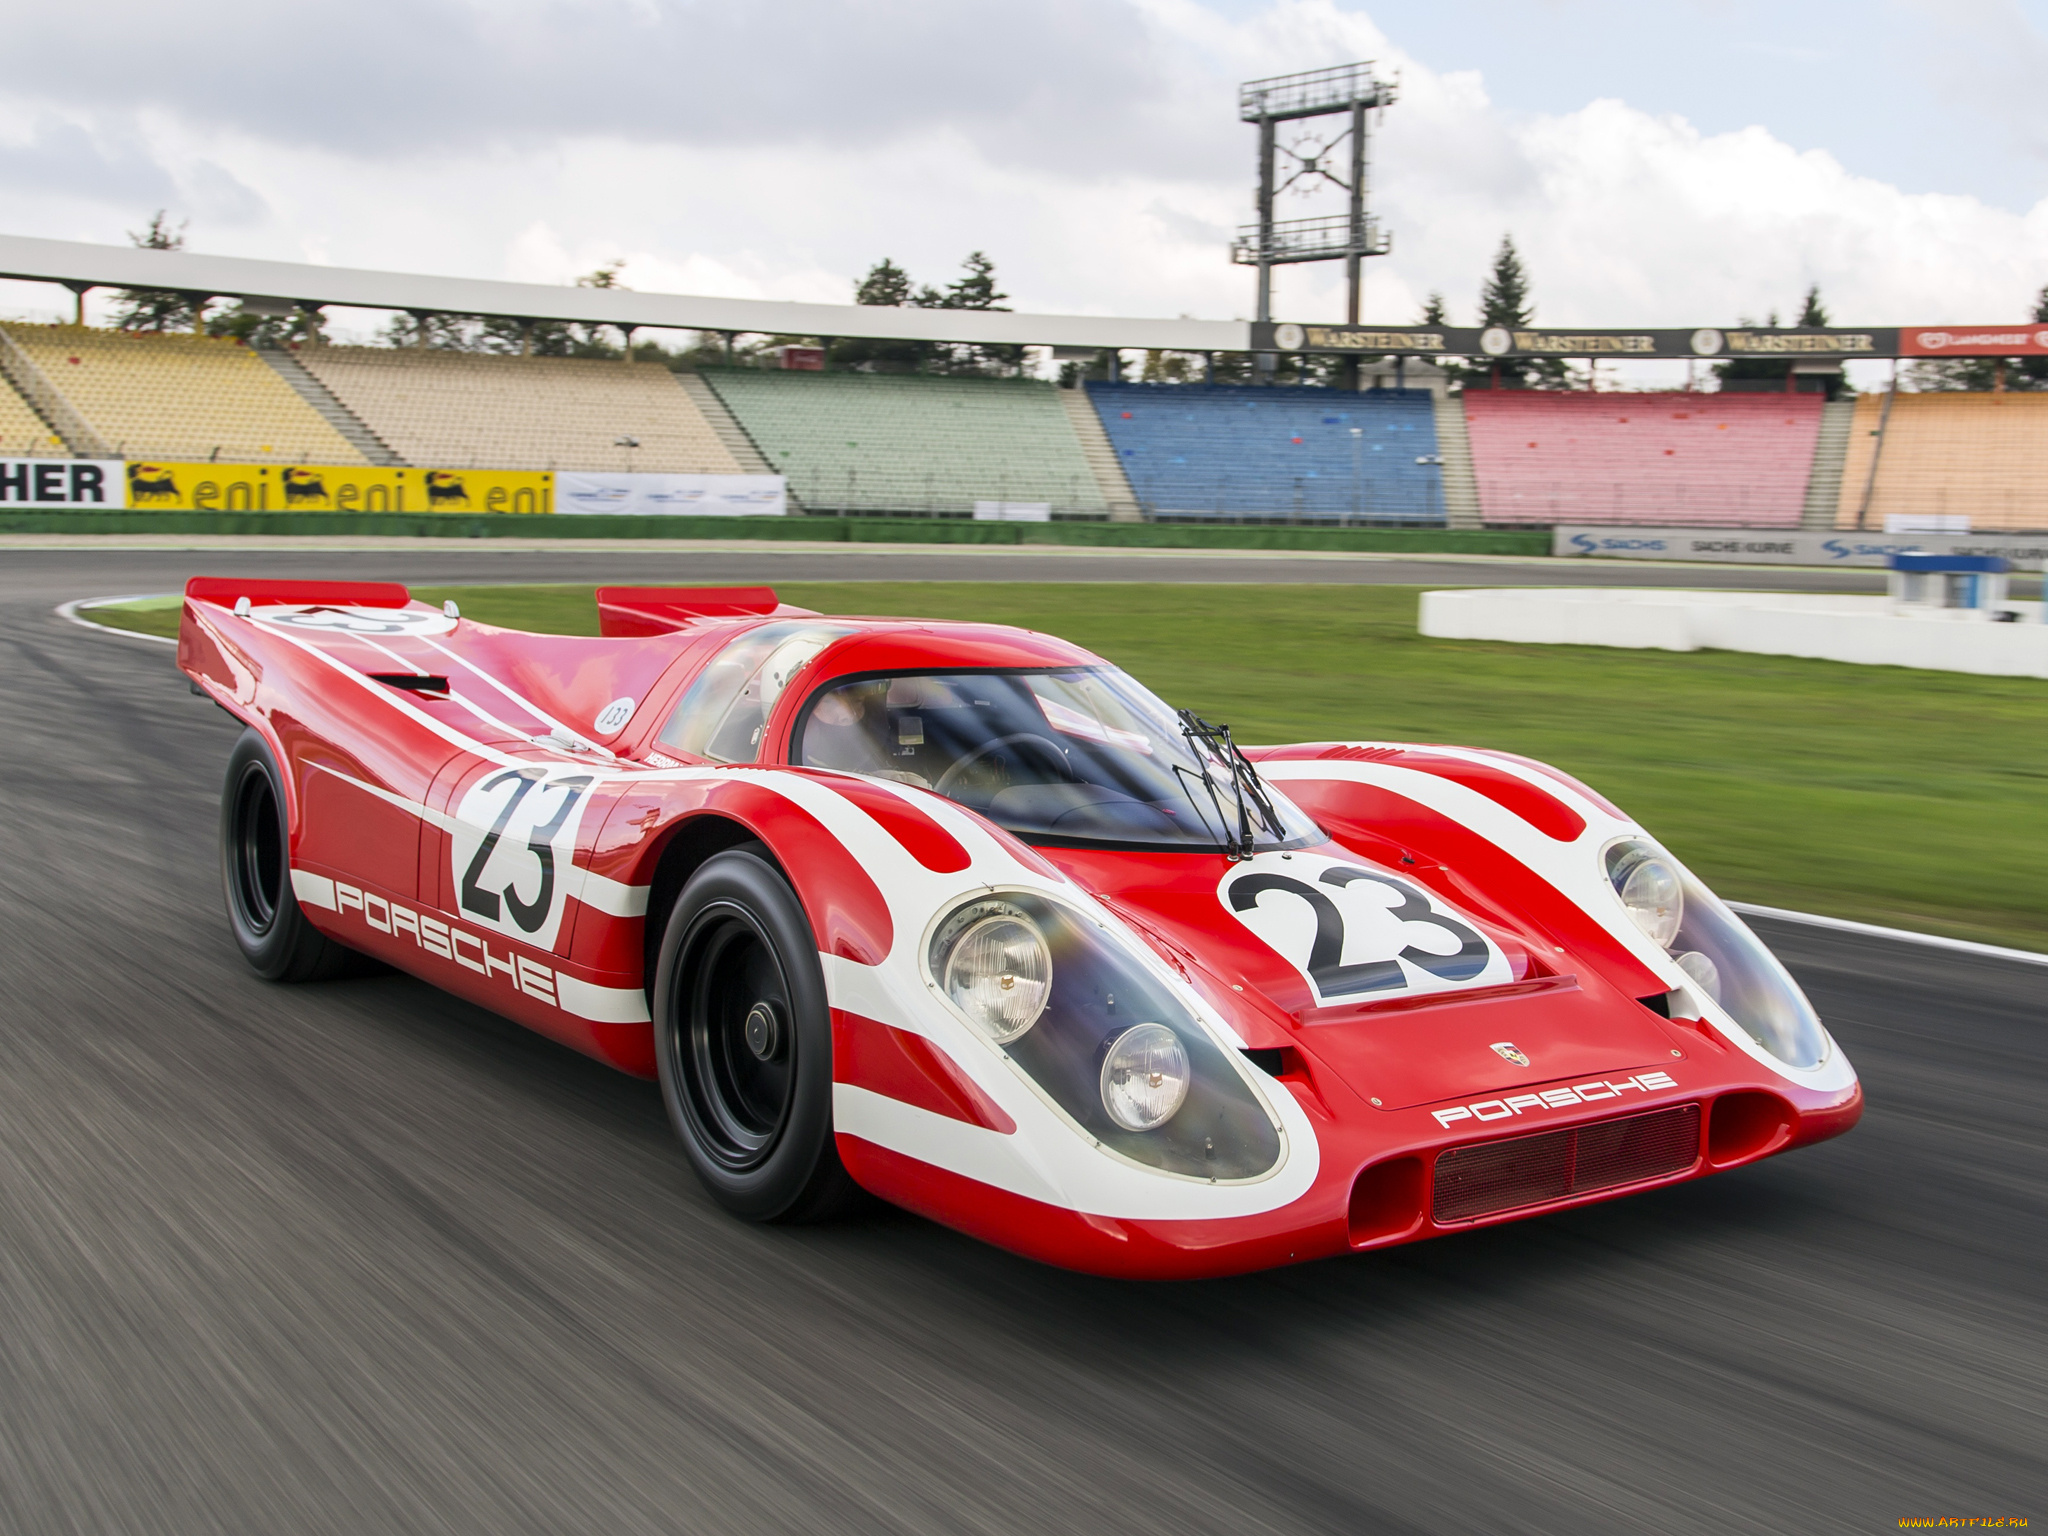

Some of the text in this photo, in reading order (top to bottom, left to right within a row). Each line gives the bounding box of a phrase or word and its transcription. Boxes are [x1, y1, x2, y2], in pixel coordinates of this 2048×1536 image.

[1305, 327, 1446, 350] WARSTEINER
[1512, 331, 1657, 352] WARSTEINER
[1725, 331, 1875, 351] WARSTEINER
[0, 463, 104, 502] HER
[192, 468, 268, 510] eni
[336, 471, 404, 512] eni
[485, 475, 551, 514] eni
[601, 706, 628, 726] 133
[461, 767, 594, 933] 23
[335, 881, 557, 1007] PORSCHE
[1228, 867, 1490, 998] 23
[1431, 1071, 1678, 1129] PORSCHE
